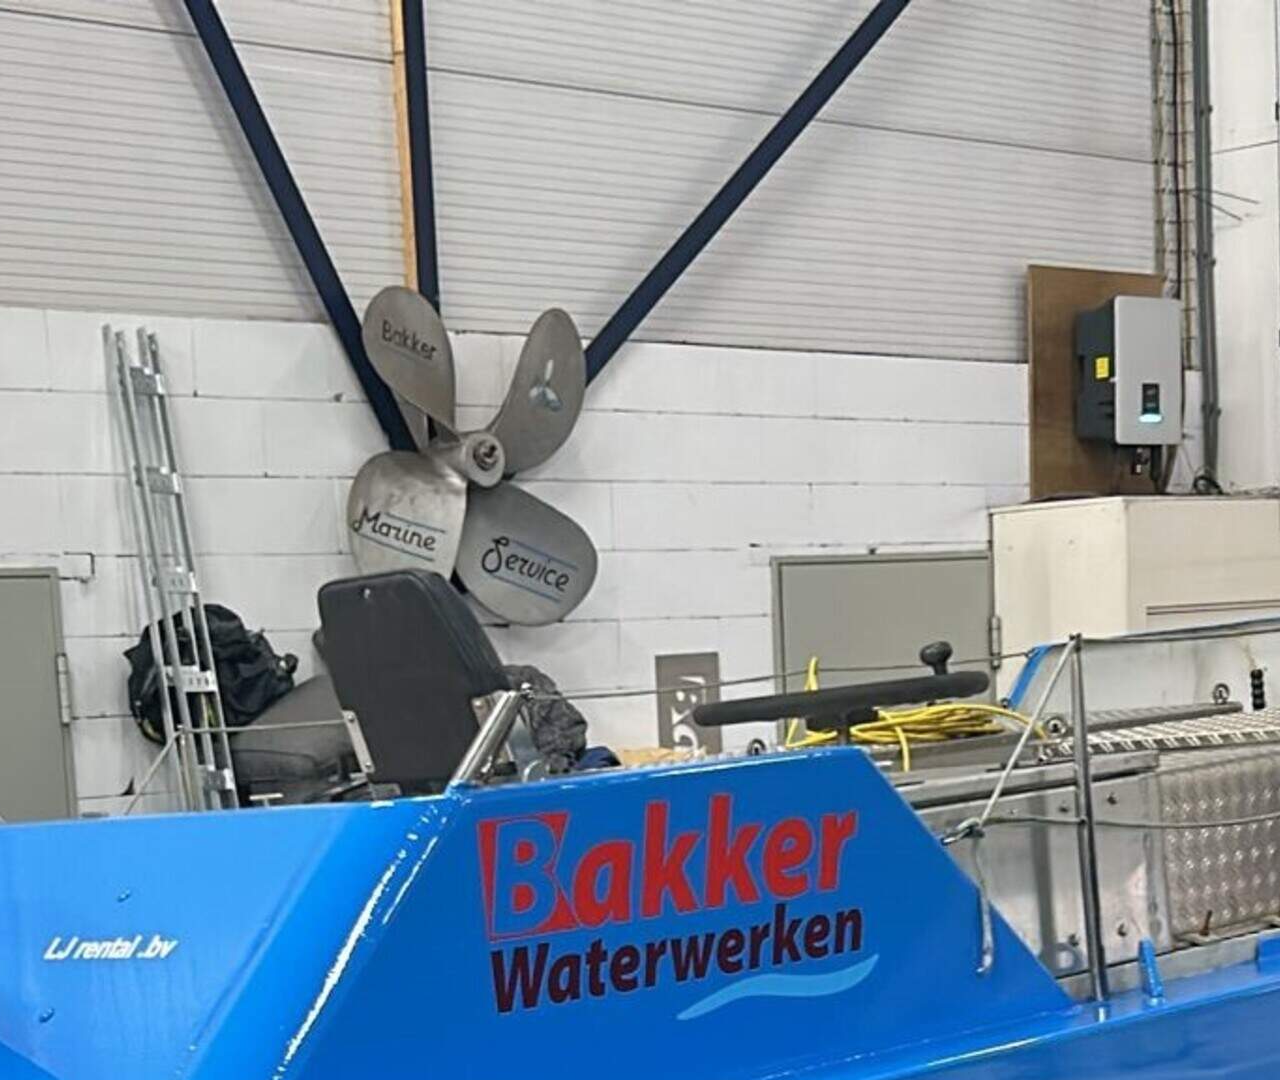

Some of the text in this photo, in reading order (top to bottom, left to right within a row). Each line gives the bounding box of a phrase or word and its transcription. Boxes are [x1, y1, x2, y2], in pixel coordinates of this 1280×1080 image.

[381, 319, 437, 361] Bakker
[351, 506, 437, 552] Marine
[481, 535, 570, 592] Service
[476, 794, 859, 942] Bakker
[43, 936, 79, 961] LJ
[72, 934, 143, 960] rental
[490, 903, 863, 1014] Waterwerken
